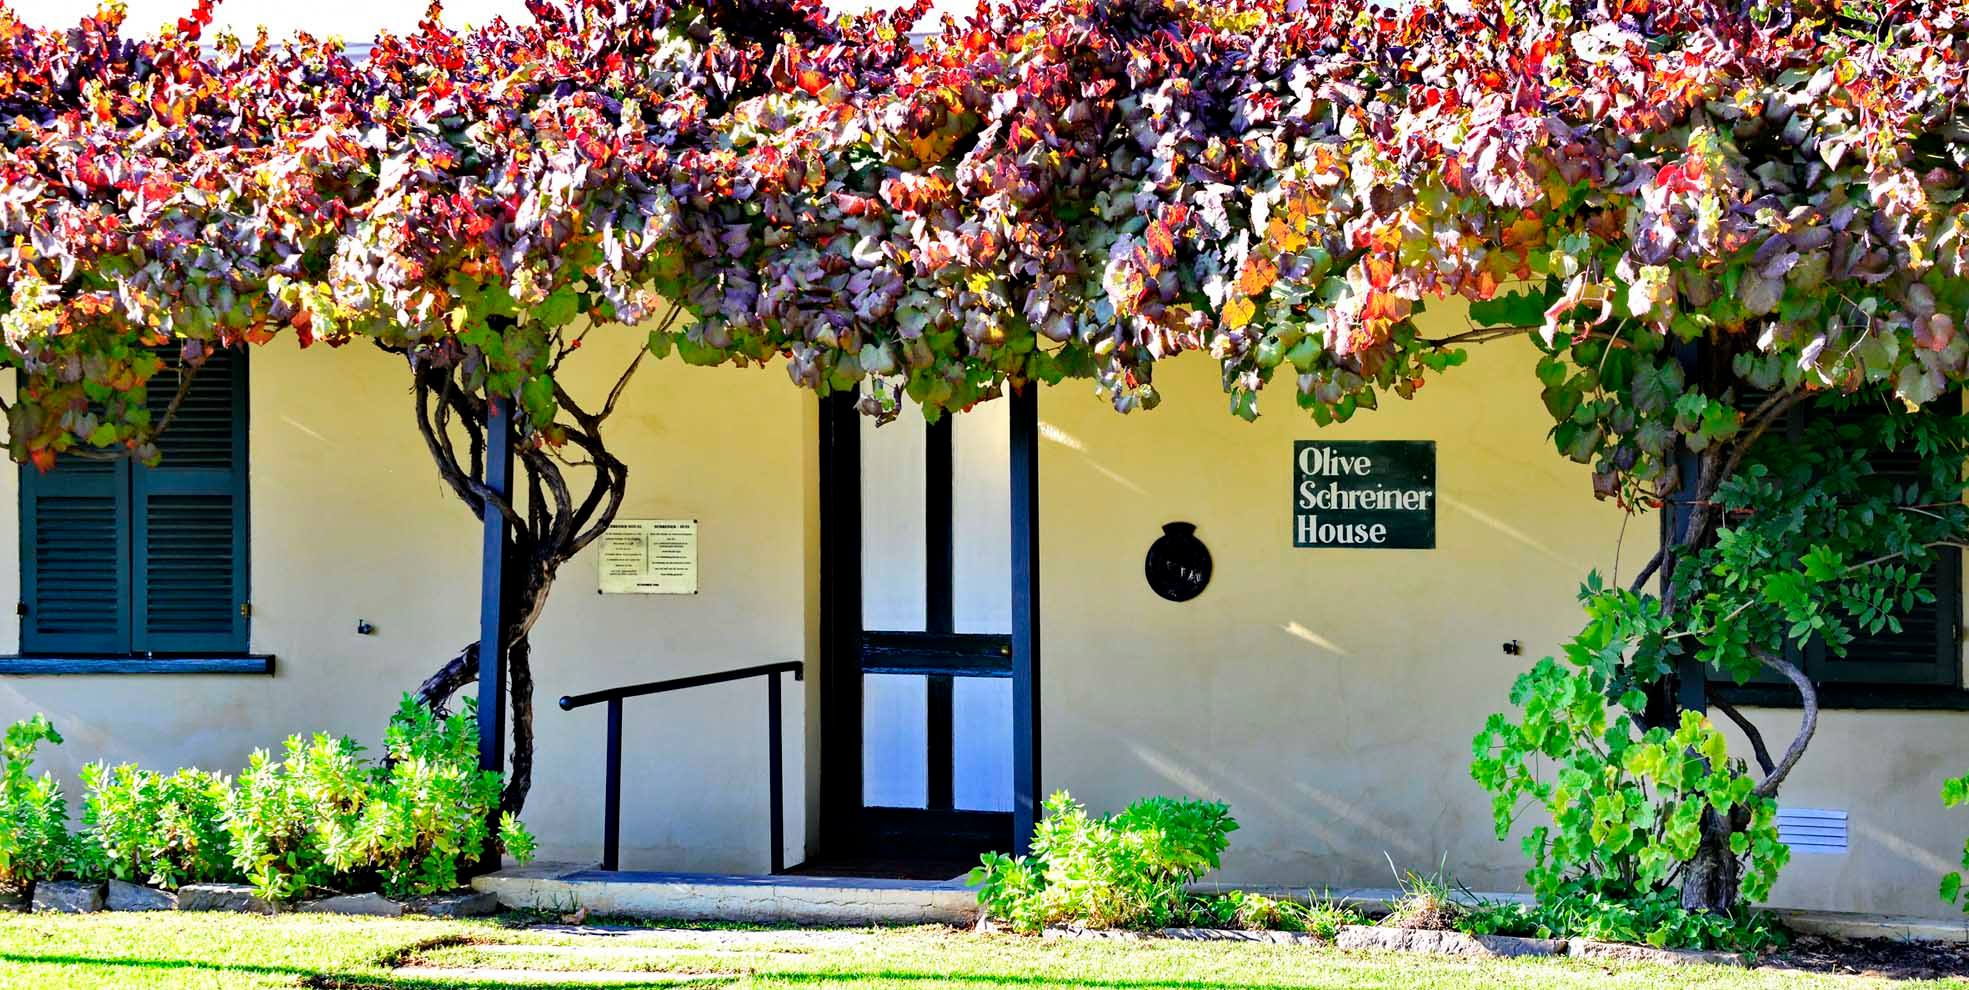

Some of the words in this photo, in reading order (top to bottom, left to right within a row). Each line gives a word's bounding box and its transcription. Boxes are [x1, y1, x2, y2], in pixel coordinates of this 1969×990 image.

[1298, 446, 1371, 476] Olive
[1299, 480, 1433, 511] Schreiner
[1297, 514, 1387, 544] House
